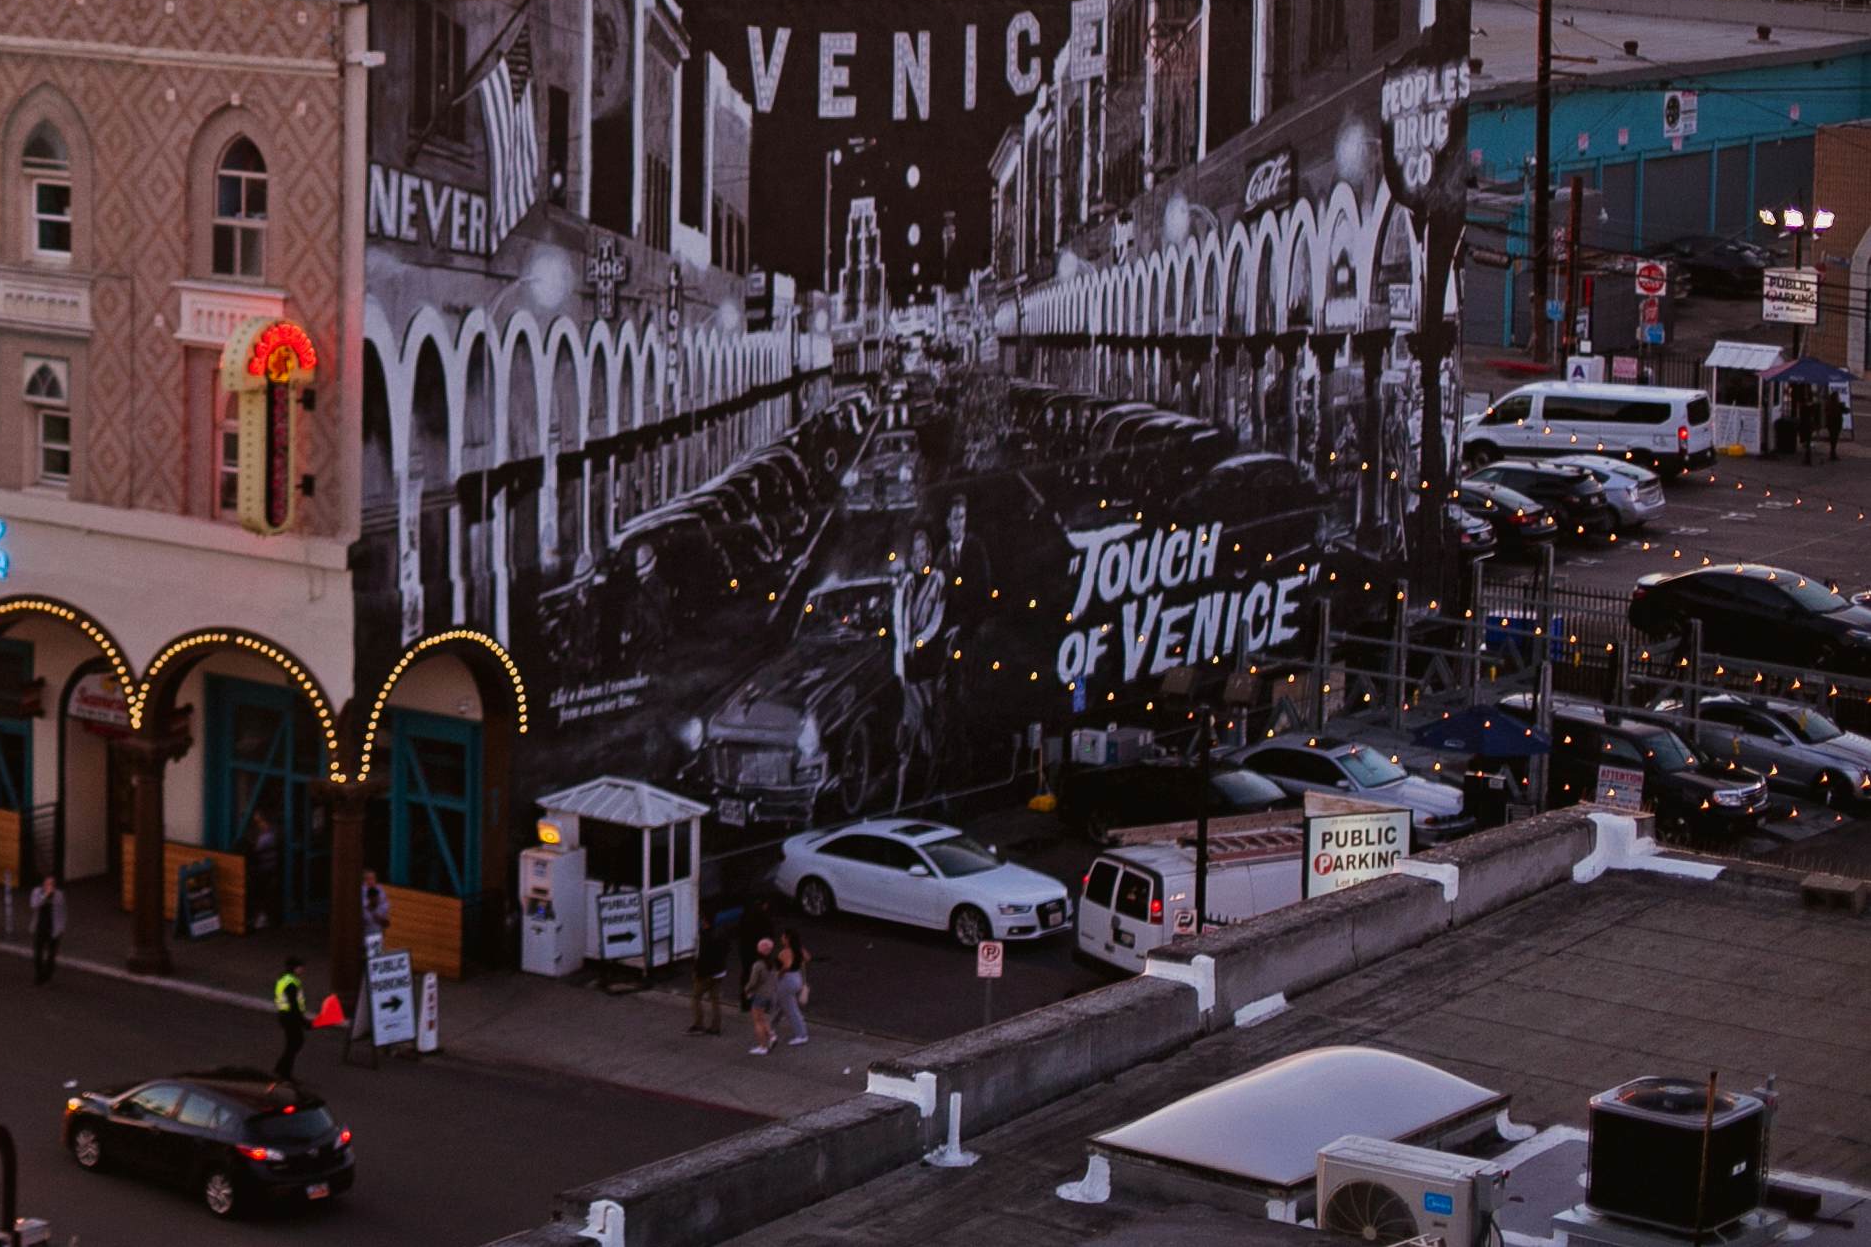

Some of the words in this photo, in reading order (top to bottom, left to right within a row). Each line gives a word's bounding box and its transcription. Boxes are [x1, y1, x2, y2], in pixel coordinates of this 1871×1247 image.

[1381, 61, 1471, 123] PEOPLES
[1393, 109, 1449, 150] DRUG
[368, 164, 487, 253] NEVER
[666, 265, 679, 385] LIQUOR
[1057, 623, 1113, 684] OF
[1321, 826, 1397, 850] PUBLIC
[603, 897, 642, 910] PUBLIC
[603, 912, 642, 926] PARKING
[371, 957, 406, 974] PUBLIC
[370, 974, 411, 992] PARKING
